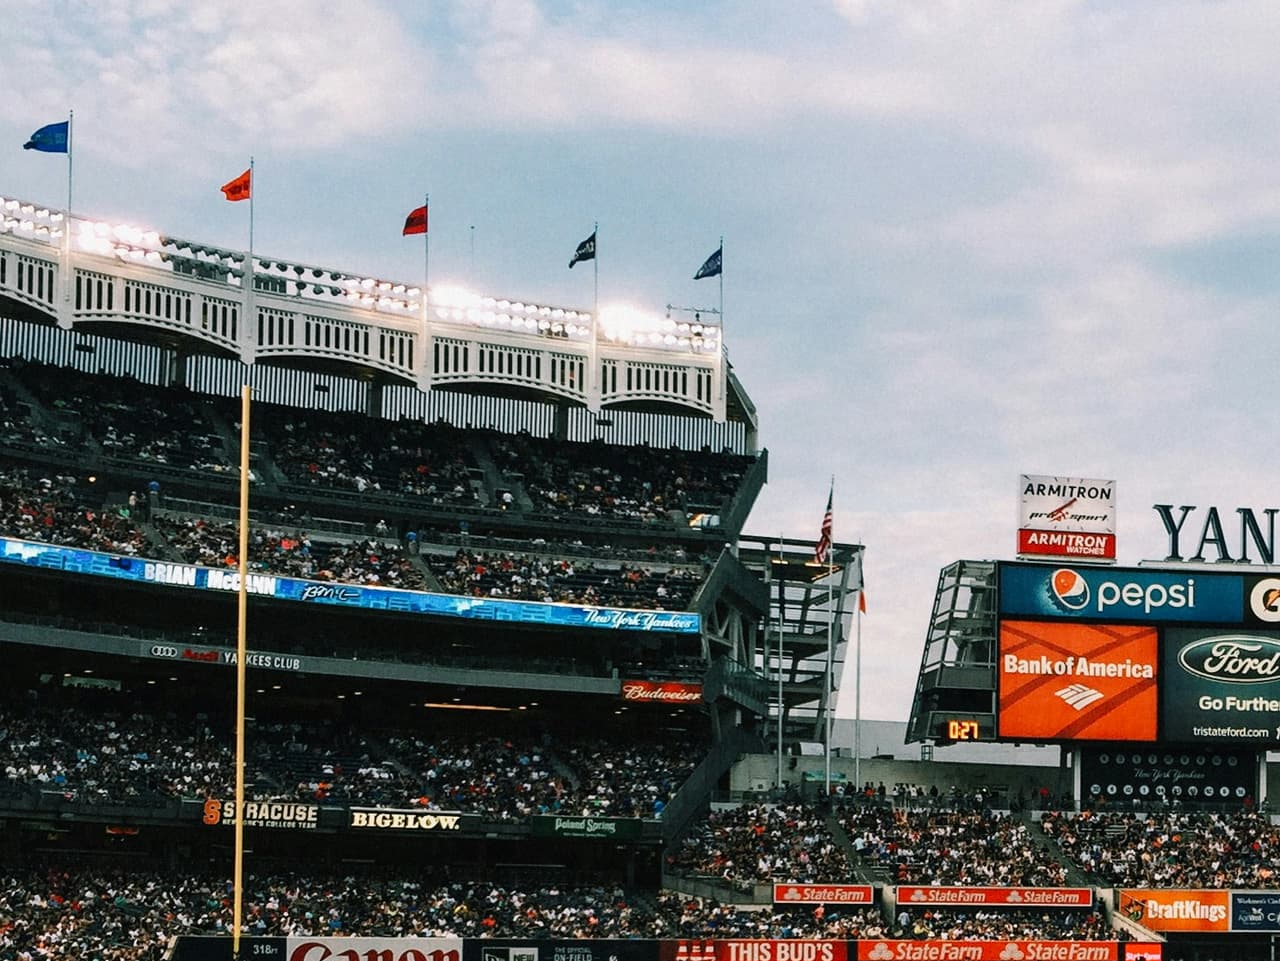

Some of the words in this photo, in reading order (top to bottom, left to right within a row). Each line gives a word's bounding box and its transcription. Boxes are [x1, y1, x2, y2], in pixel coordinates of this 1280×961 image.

[1024, 483, 1111, 500] ARMITRON
[1069, 513, 1109, 522] sport
[1028, 533, 1108, 548] ARMITRON
[1066, 546, 1105, 555] WATCHES
[144, 563, 196, 586] BRIAN
[1097, 579, 1195, 613] pepsi
[582, 608, 611, 623] New
[611, 611, 640, 629] York
[642, 613, 693, 631] Yankees
[224, 652, 271, 667] YAKEES
[273, 657, 300, 670] CLUB
[1004, 654, 1052, 675] Bank
[1053, 656, 1077, 676] of
[1077, 656, 1154, 680] America
[1203, 641, 1280, 676] Ford
[622, 685, 702, 701] Budweiser
[1199, 696, 1223, 711] Go
[950, 721, 978, 740] 0:27
[1193, 726, 1268, 740] tristateford.com
[203, 799, 221, 825] S
[223, 803, 318, 822] SRACUSE
[555, 818, 585, 830] Poland
[586, 819, 616, 833] Spring
[1148, 900, 1226, 922] DraftKings
[513, 954, 535, 961] NEW
[728, 943, 771, 961] THIS
[777, 943, 833, 961] BUD'S
